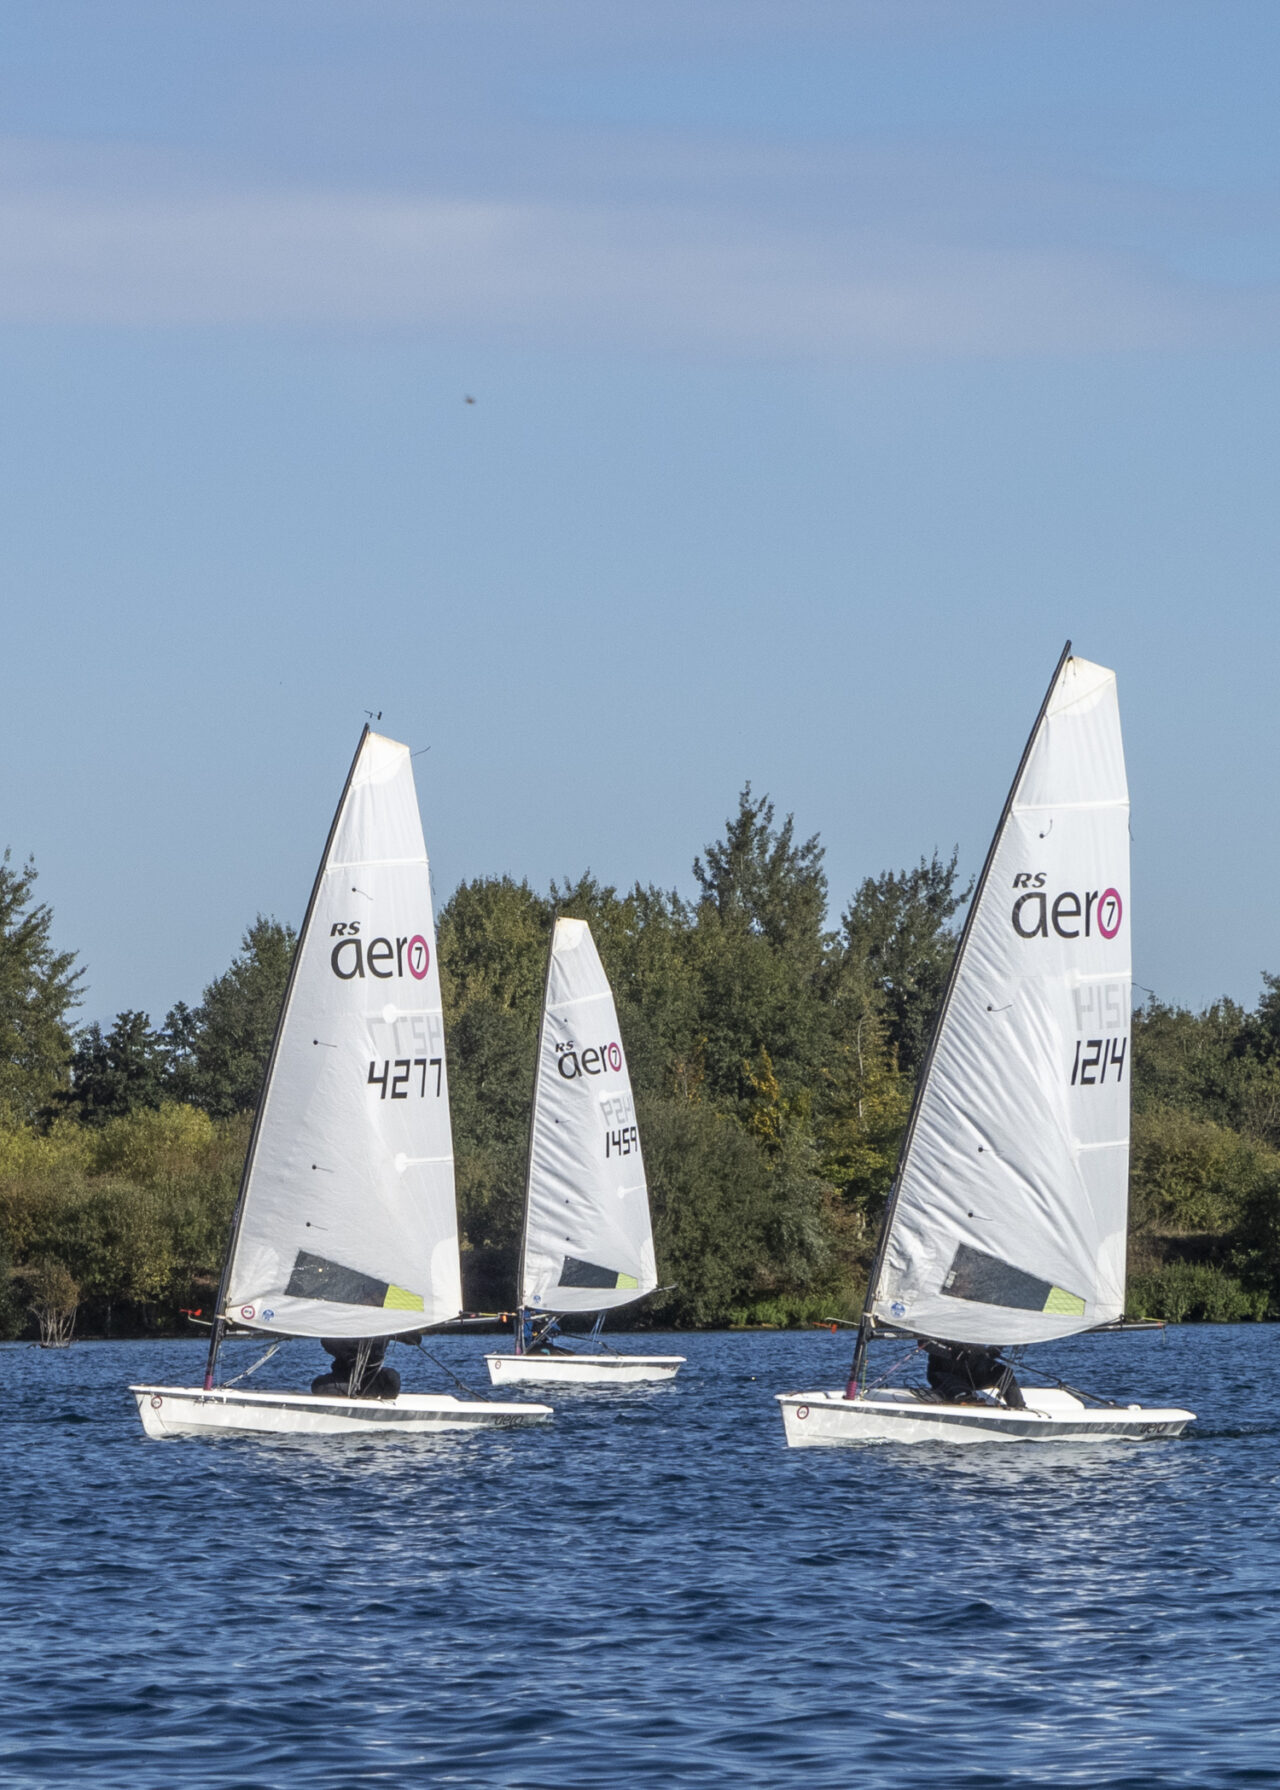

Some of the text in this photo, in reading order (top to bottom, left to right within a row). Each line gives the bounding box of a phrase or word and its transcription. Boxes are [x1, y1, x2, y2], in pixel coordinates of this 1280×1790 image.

[1012, 873, 1047, 888] RS
[330, 921, 361, 936] RS
[555, 1041, 574, 1052] RS
[1071, 1037, 1127, 1086] 1214
[367, 1058, 442, 1100] 4277
[606, 1126, 638, 1158] 1459
